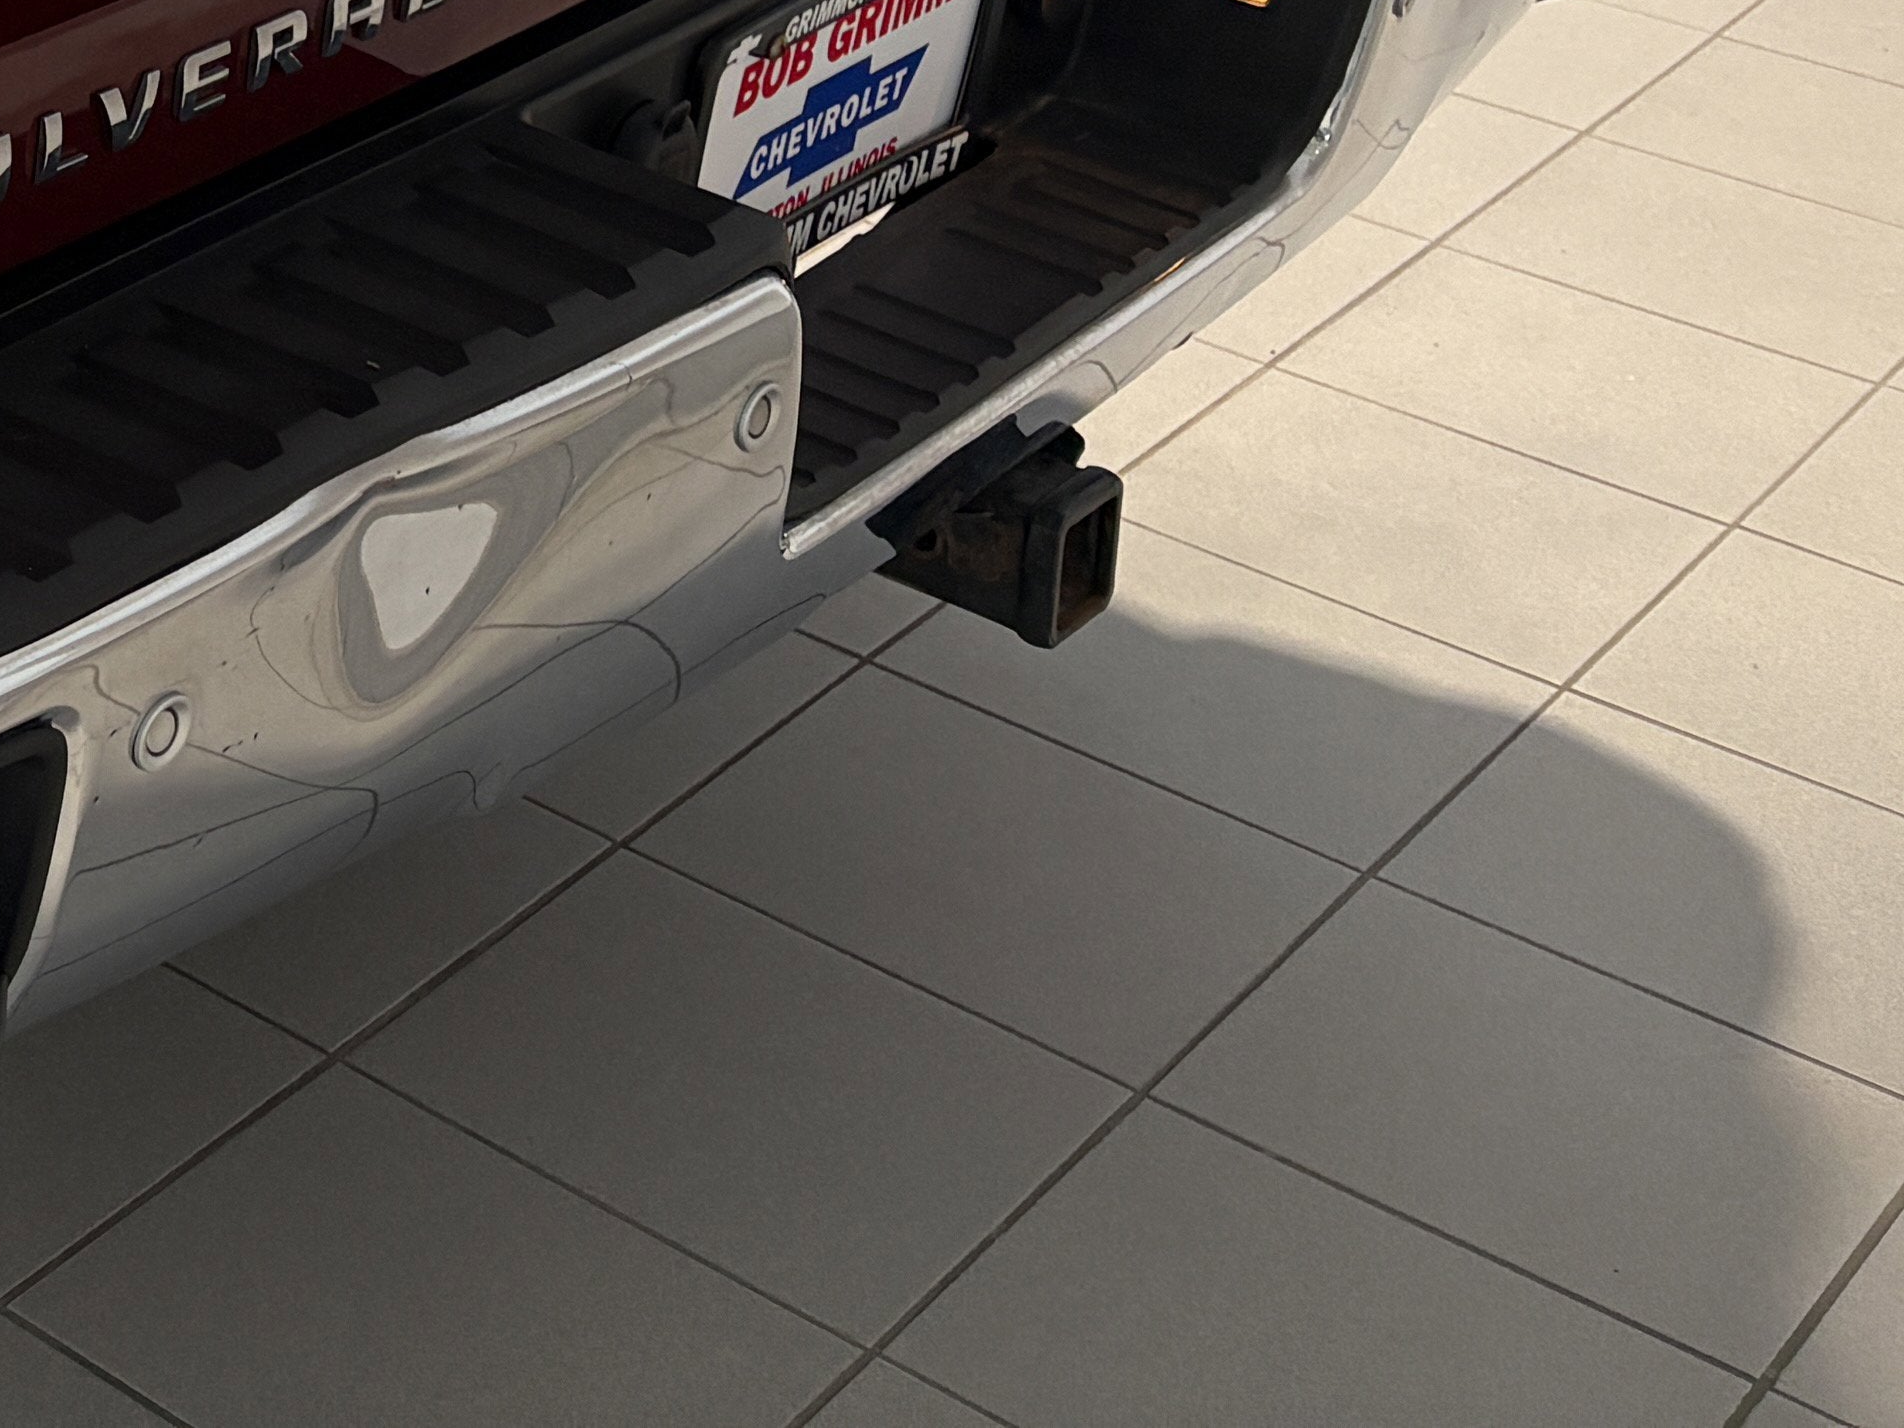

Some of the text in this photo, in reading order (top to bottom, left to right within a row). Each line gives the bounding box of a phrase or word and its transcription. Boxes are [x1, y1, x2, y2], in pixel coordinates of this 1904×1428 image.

[733, 30, 818, 119] BOB
[750, 67, 909, 180] CHEVROLET
[817, 130, 969, 241] CHEVROLET
[820, 136, 898, 194] ILLINOIS
